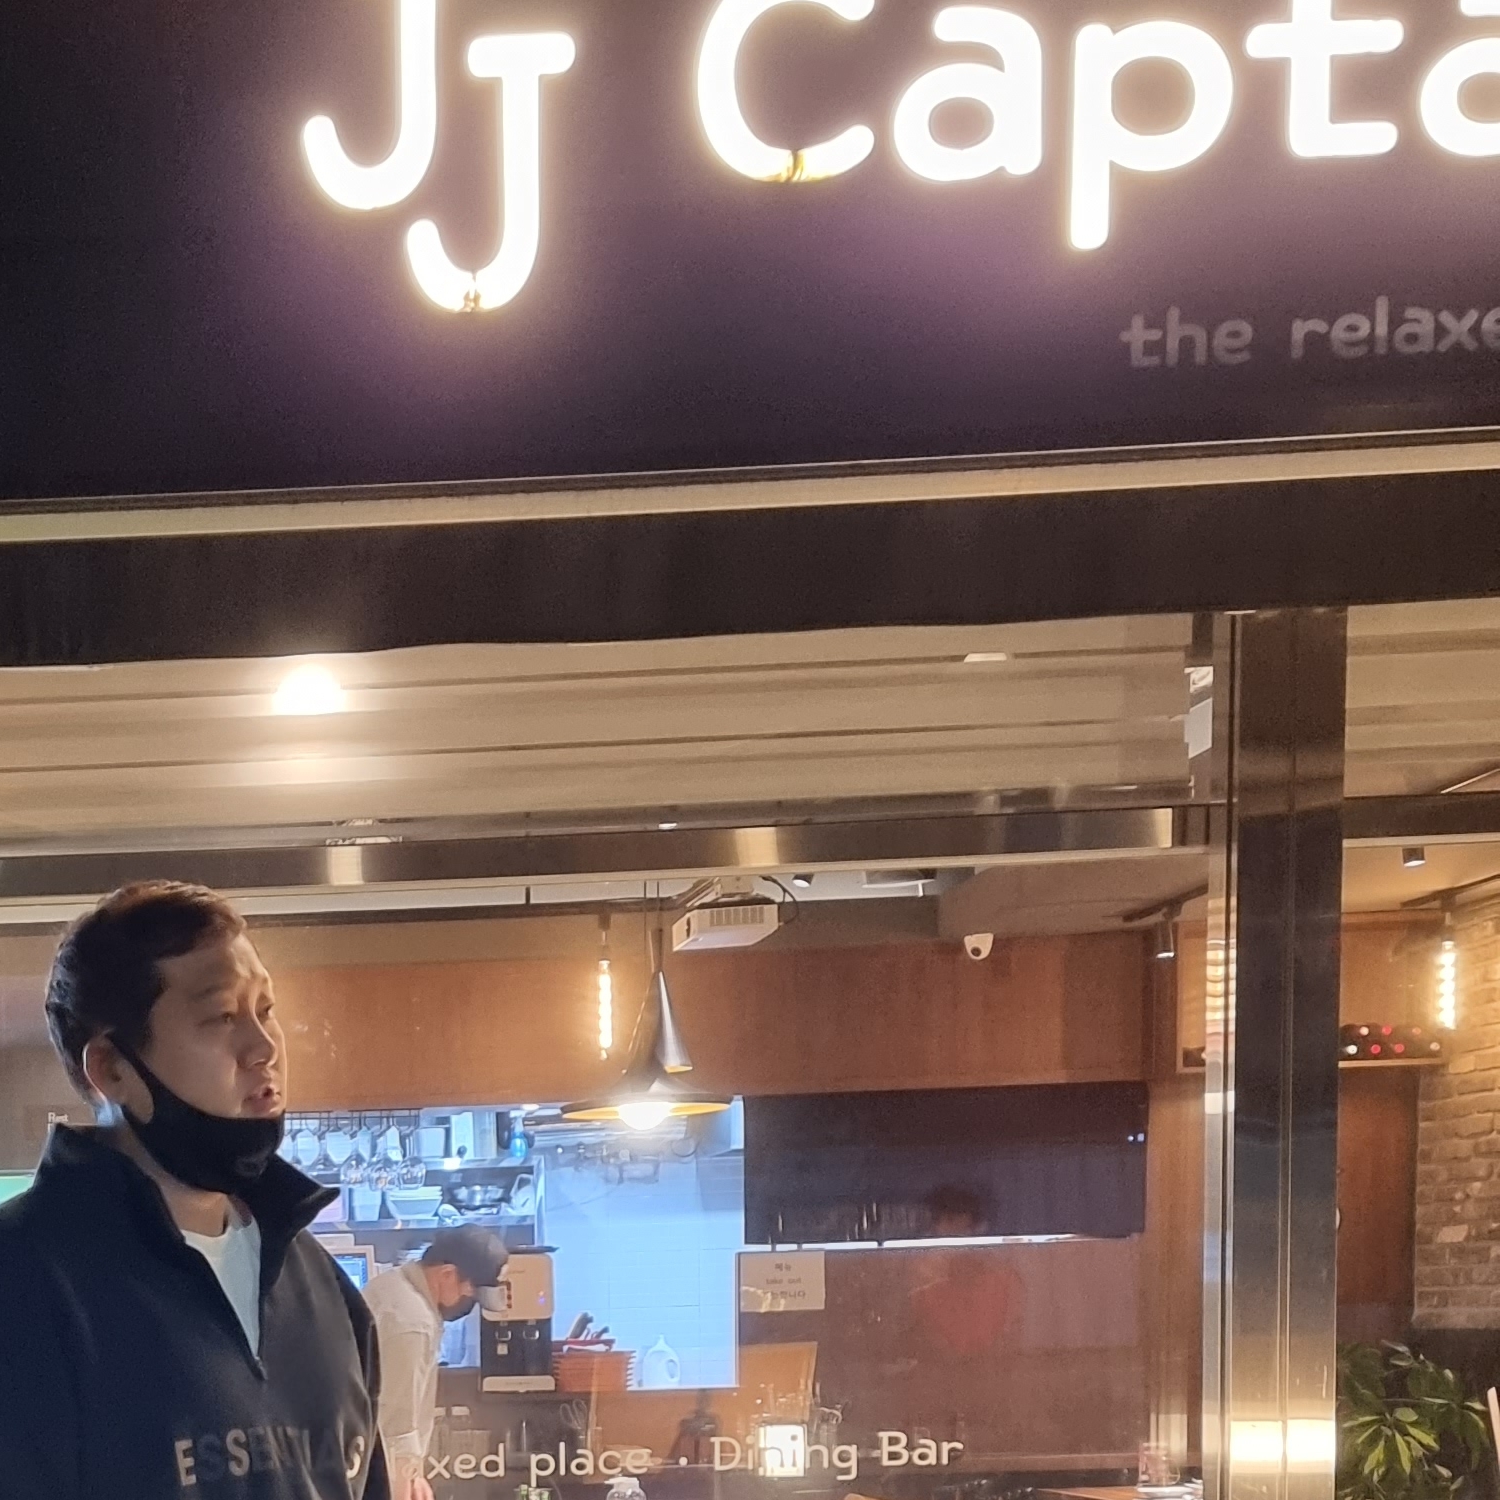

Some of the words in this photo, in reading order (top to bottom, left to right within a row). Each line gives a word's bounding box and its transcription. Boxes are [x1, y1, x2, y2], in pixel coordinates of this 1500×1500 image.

[1118, 305, 1254, 368] the
[529, 1441, 652, 1489] place
[710, 1434, 859, 1481] Dining
[877, 1430, 965, 1468] Bar
